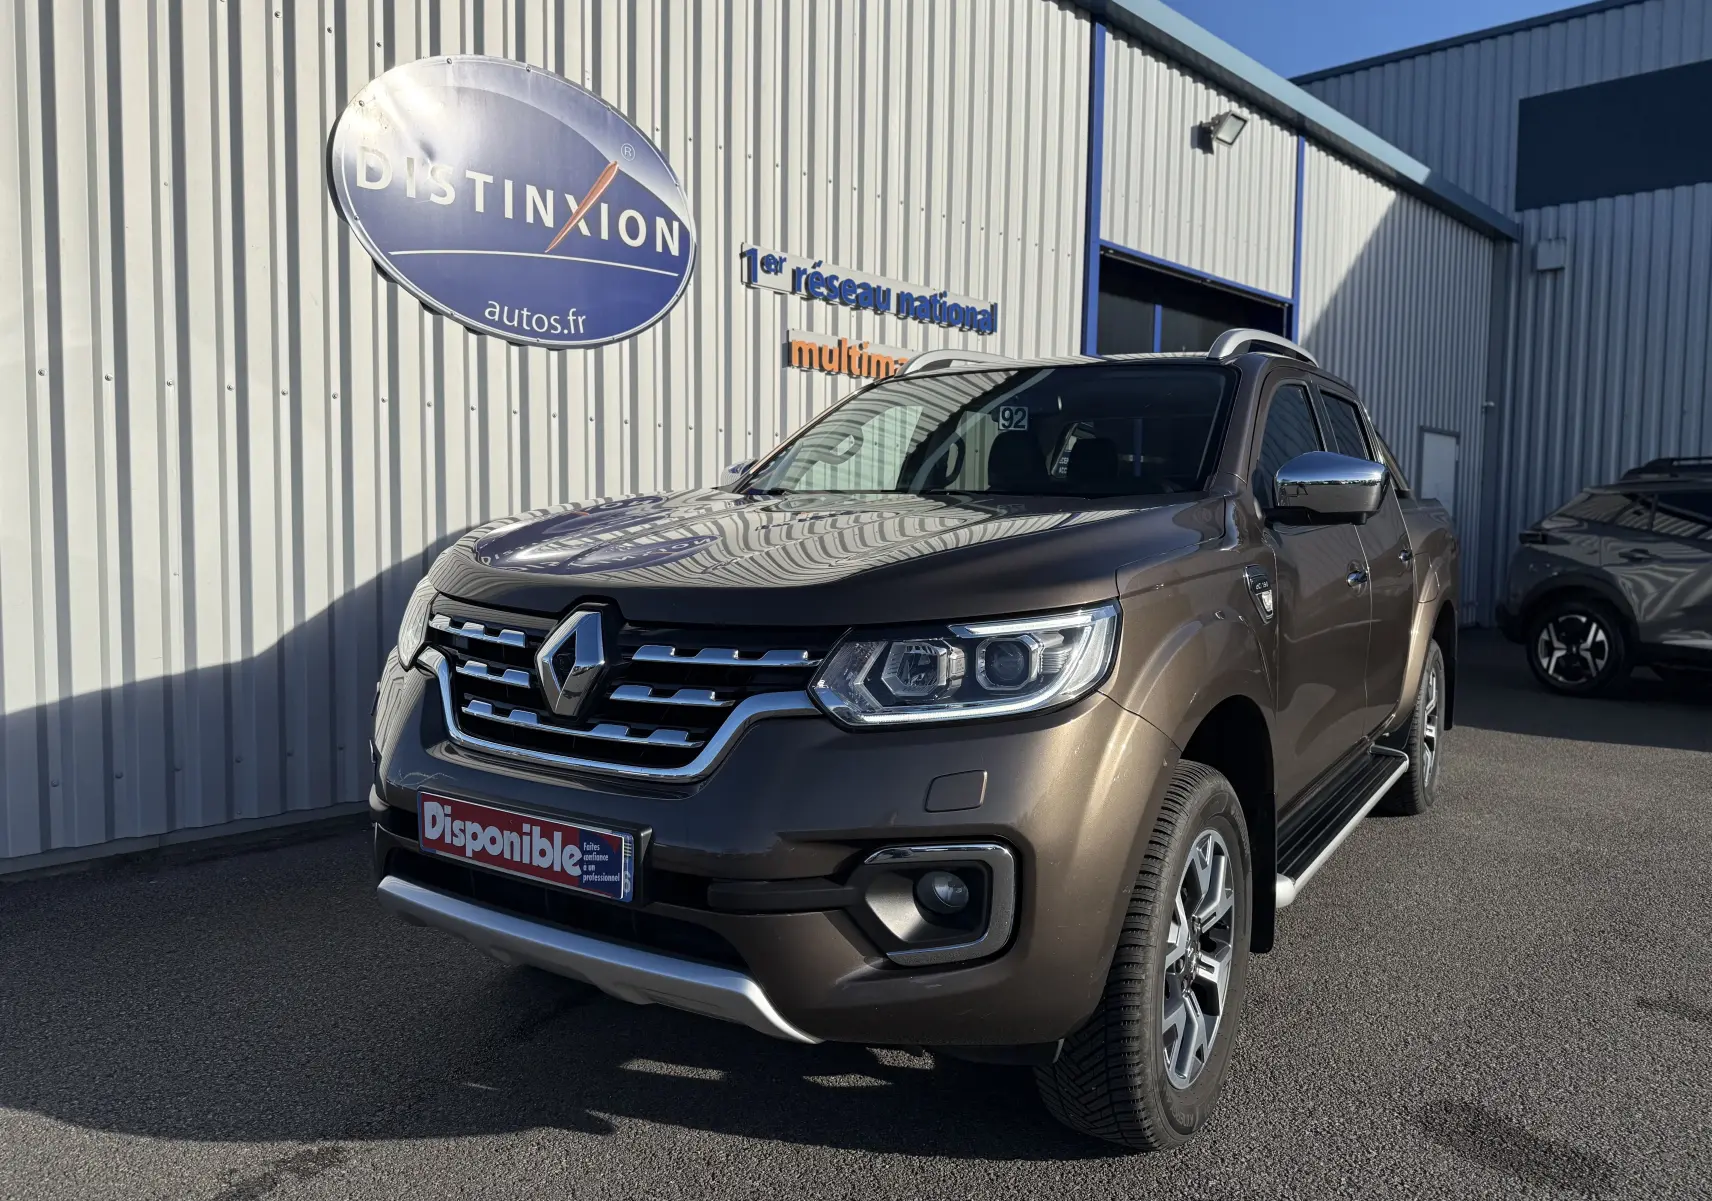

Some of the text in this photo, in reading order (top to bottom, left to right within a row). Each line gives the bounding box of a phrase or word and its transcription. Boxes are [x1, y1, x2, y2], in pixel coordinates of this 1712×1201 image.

[356, 145, 680, 256] DISTINXION
[795, 260, 891, 311] réseau
[900, 290, 998, 333] national
[484, 300, 586, 335] autos.fr
[1001, 407, 1026, 428] 92
[423, 801, 582, 876] Disponible
[583, 842, 600, 851] Faites
[583, 852, 608, 861] confiance
[583, 873, 620, 883] professionnel
